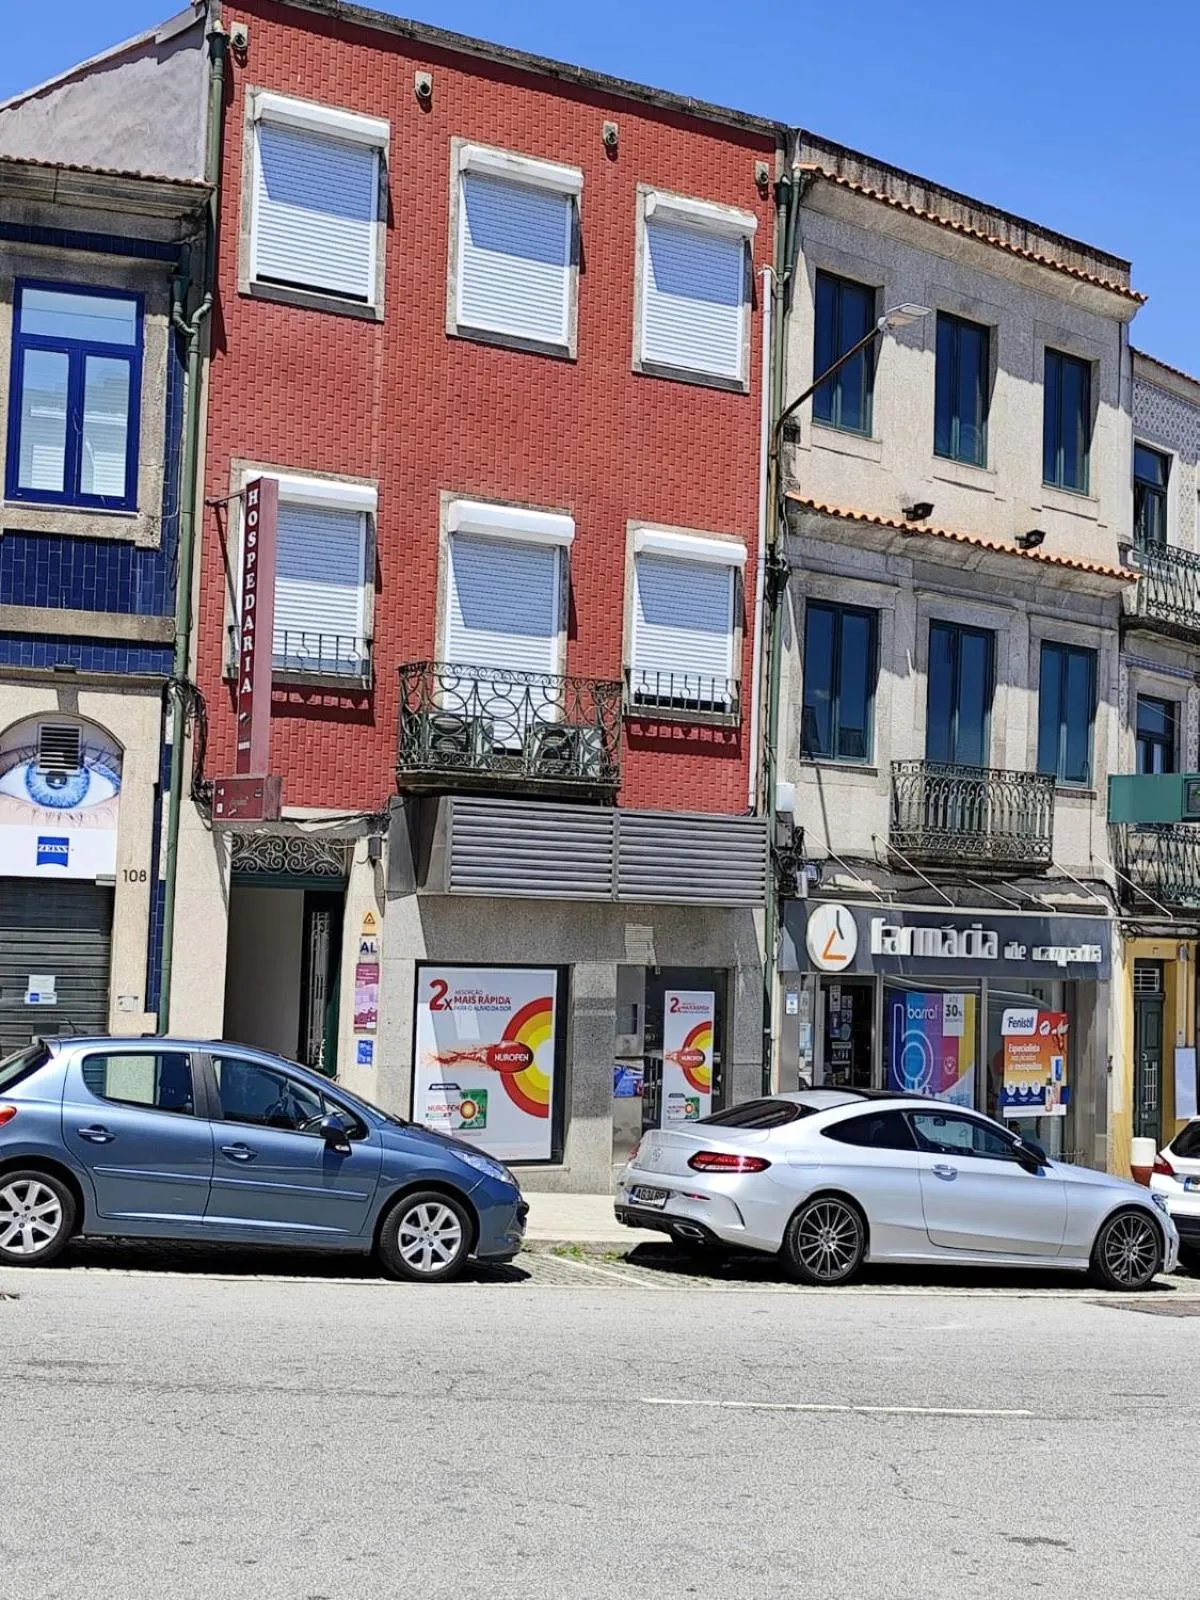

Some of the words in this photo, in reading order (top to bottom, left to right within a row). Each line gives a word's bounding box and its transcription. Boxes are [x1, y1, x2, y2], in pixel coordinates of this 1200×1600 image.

[240, 489, 259, 694] HOSPEDARIA
[38, 845, 68, 853] ZEISS
[123, 869, 147, 883] 108
[359, 942, 378, 954] AL
[454, 996, 476, 1004] MAIS
[478, 994, 511, 1005] RÁPIDA
[494, 1053, 529, 1062] NUROFEN
